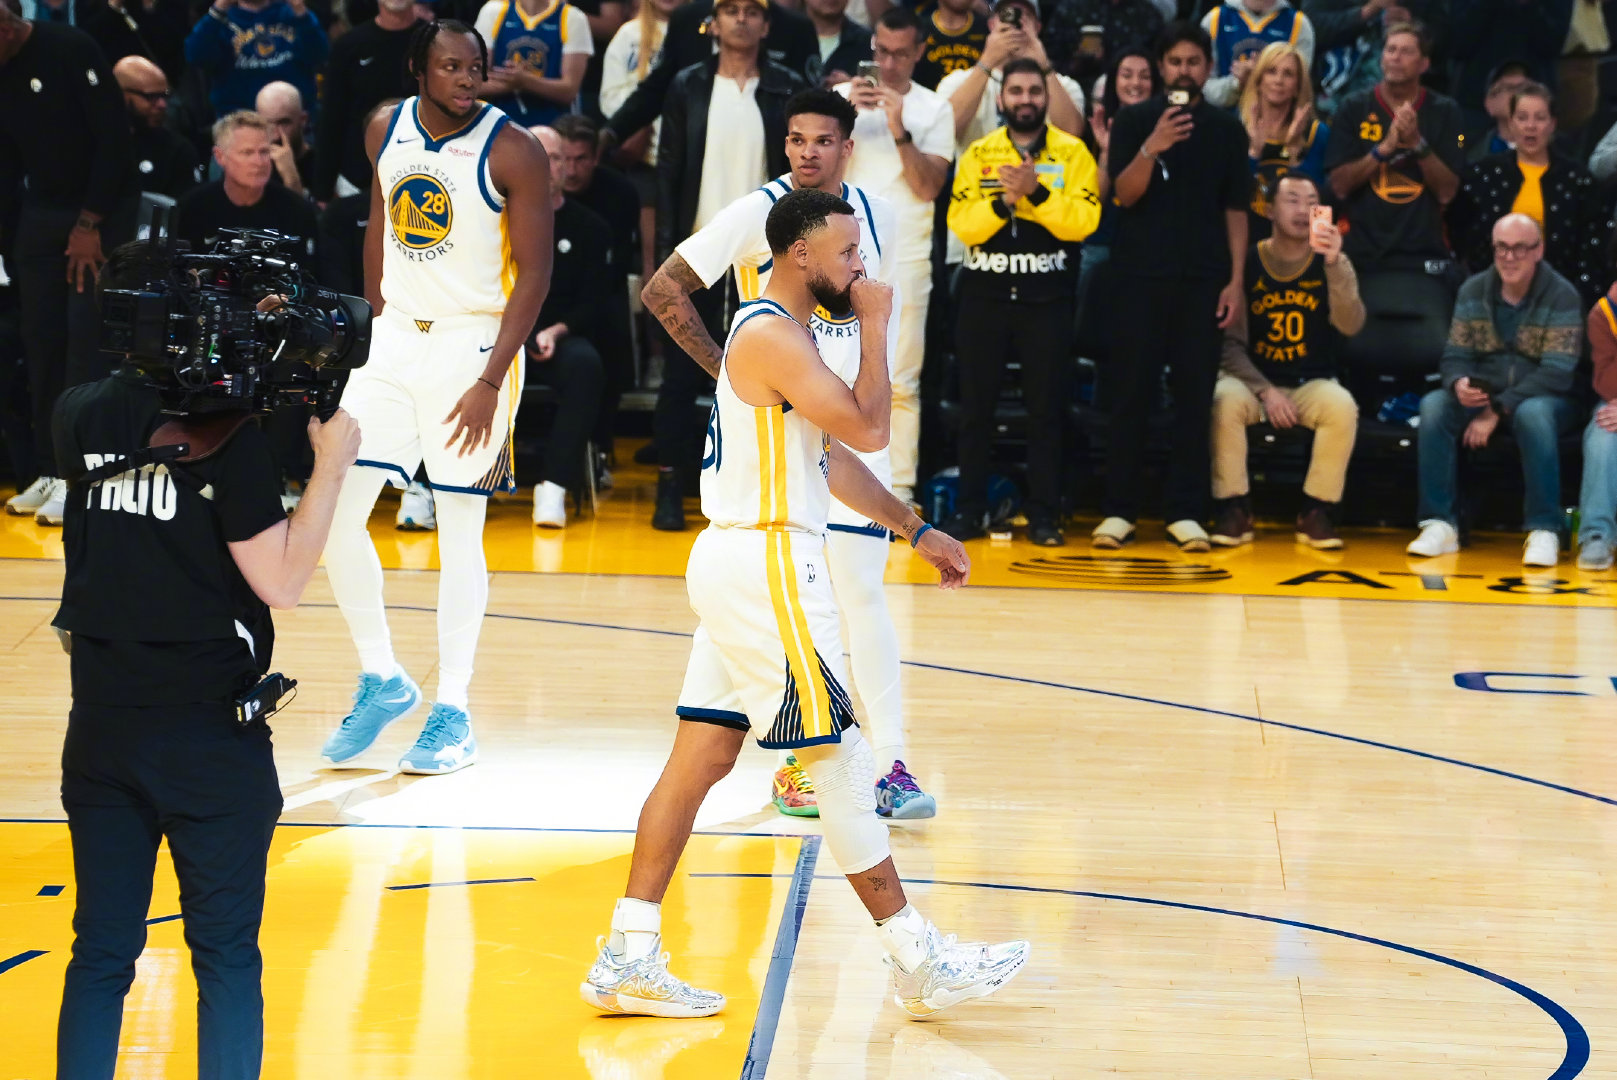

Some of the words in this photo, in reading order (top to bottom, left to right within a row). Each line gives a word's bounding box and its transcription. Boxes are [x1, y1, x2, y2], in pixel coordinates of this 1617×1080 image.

[390, 164, 430, 183] GOLDEN
[434, 168, 457, 194] STATE
[420, 190, 446, 215] 28
[1251, 290, 1318, 315] GOLDEN
[1267, 311, 1304, 342] 30
[1256, 341, 1307, 361] STATE
